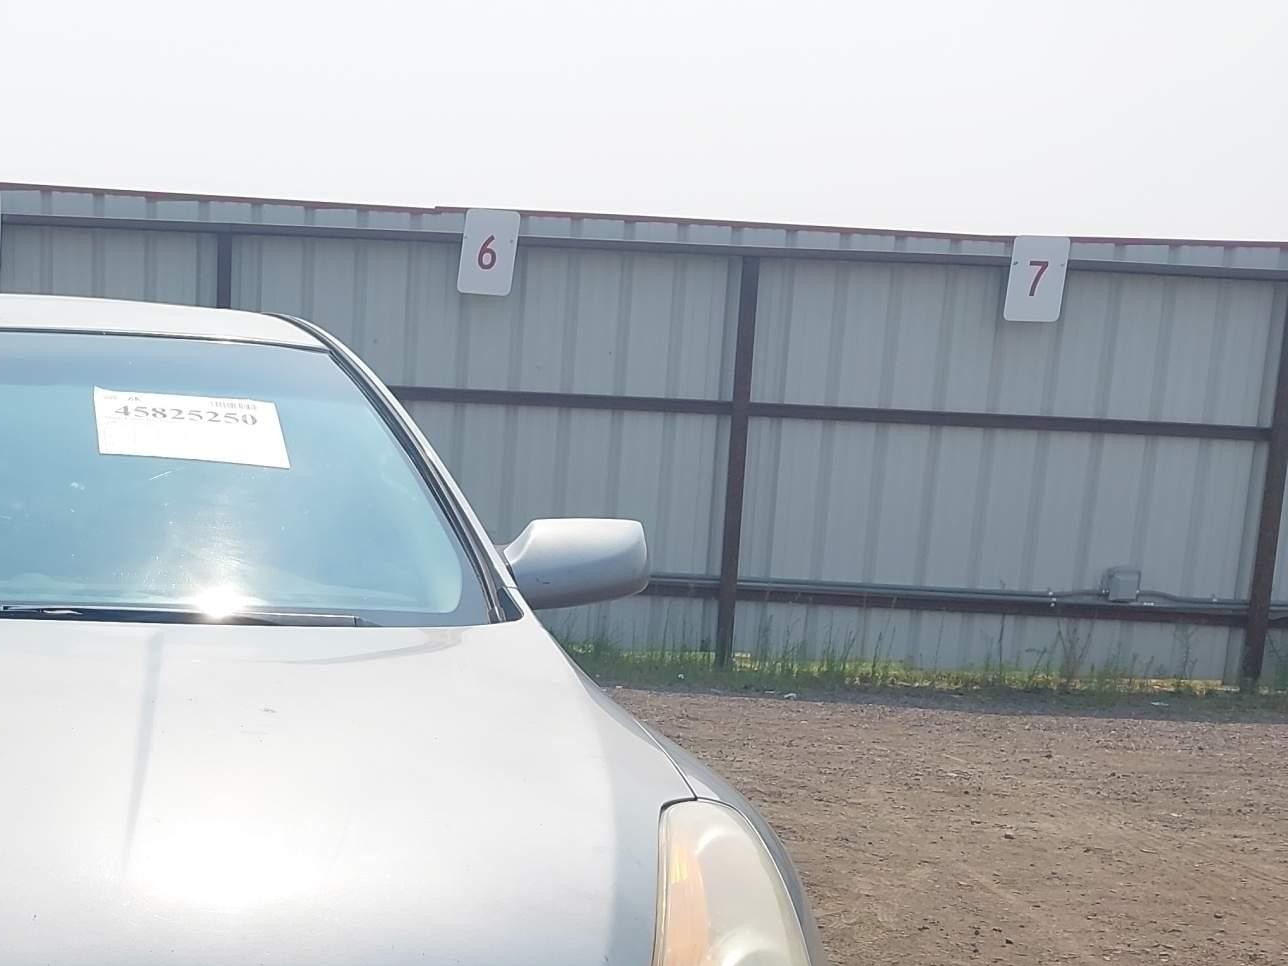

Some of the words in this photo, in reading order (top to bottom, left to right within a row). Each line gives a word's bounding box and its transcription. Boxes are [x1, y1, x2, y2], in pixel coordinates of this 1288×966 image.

[478, 235, 497, 270] 6
[1029, 261, 1049, 296] 7
[114, 405, 258, 426] 45825250
